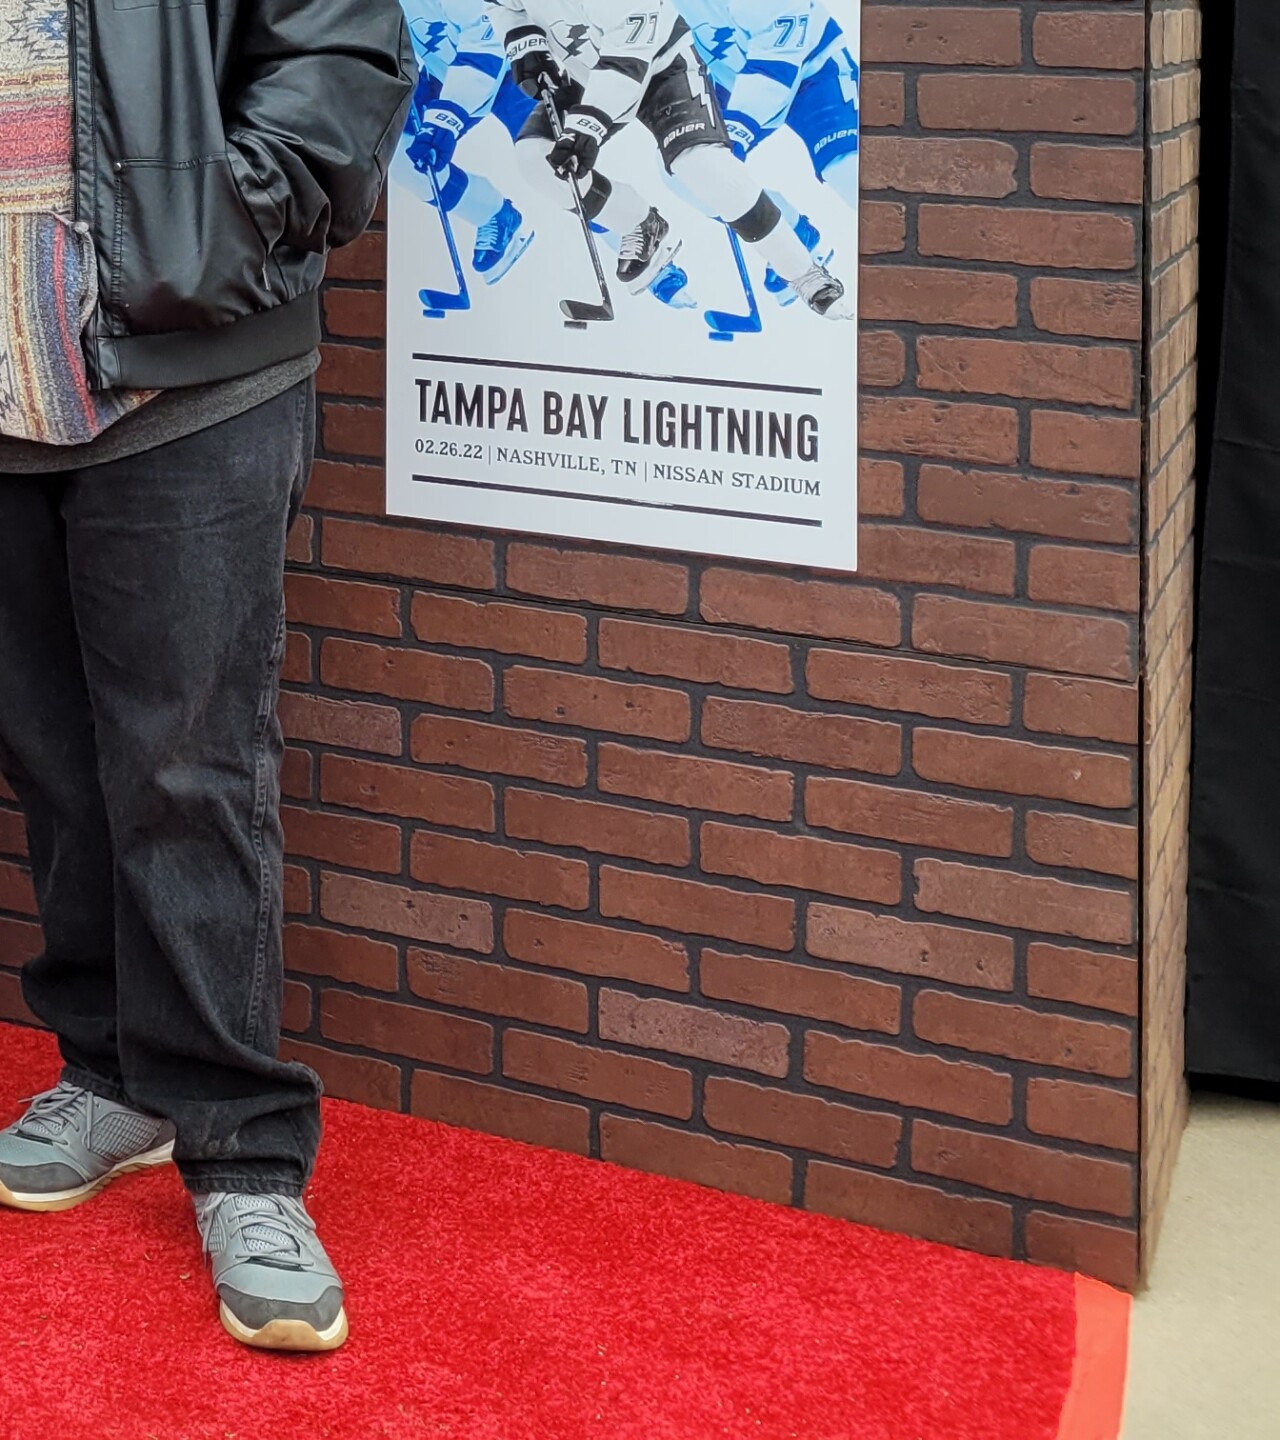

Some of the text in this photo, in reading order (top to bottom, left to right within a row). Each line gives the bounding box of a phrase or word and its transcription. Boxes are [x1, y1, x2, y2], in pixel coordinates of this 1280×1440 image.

[414, 378, 819, 463] TAMPA BAY LIGHTNING
[414, 438, 822, 497] 02.26.22 NASHVILLE, TN NISSAN STADIUM
